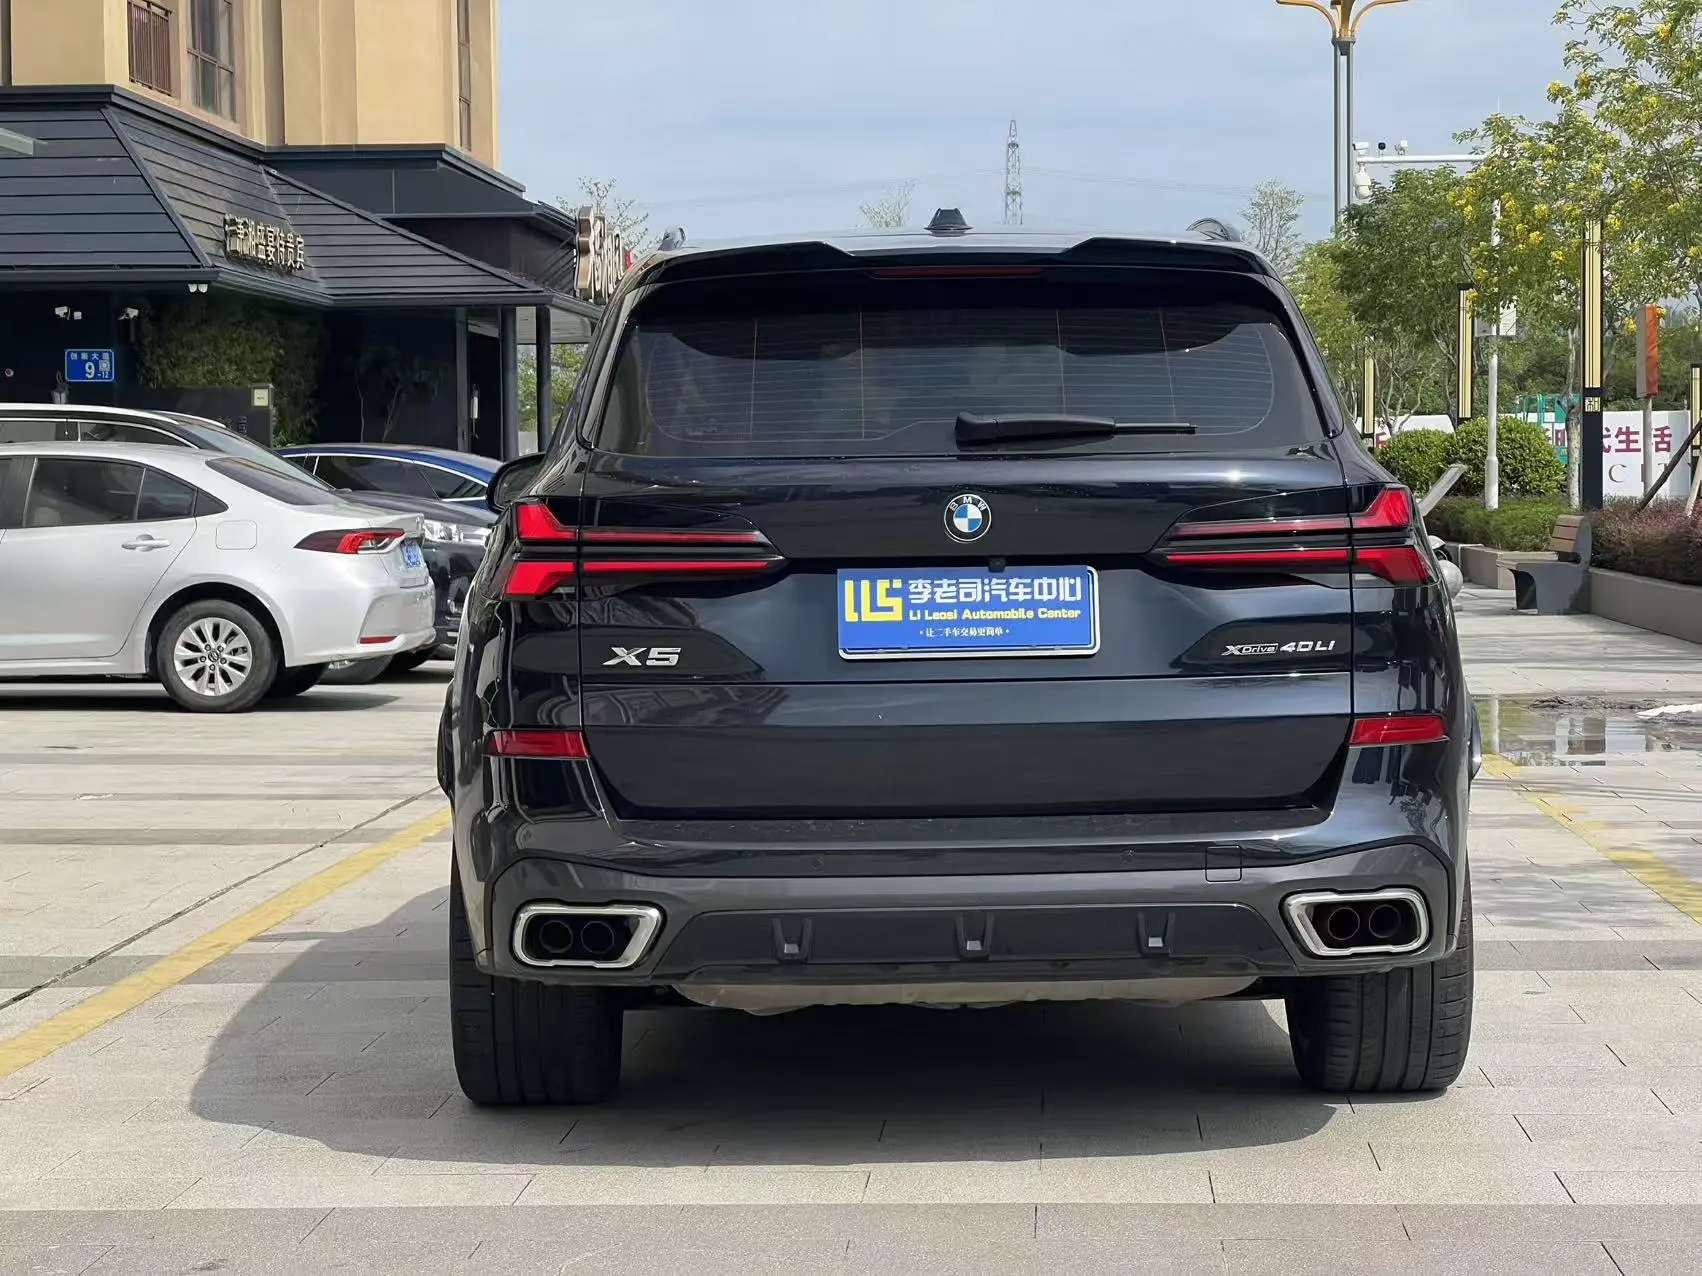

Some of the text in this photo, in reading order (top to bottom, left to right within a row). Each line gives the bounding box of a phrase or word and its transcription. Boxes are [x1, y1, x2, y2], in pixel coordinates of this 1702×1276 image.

[950, 496, 987, 511] BMW
[908, 577, 1082, 604] 李老司汽车中心
[961, 607, 1034, 620] Automobile
[1037, 607, 1081, 619] Center
[602, 647, 682, 666] X5
